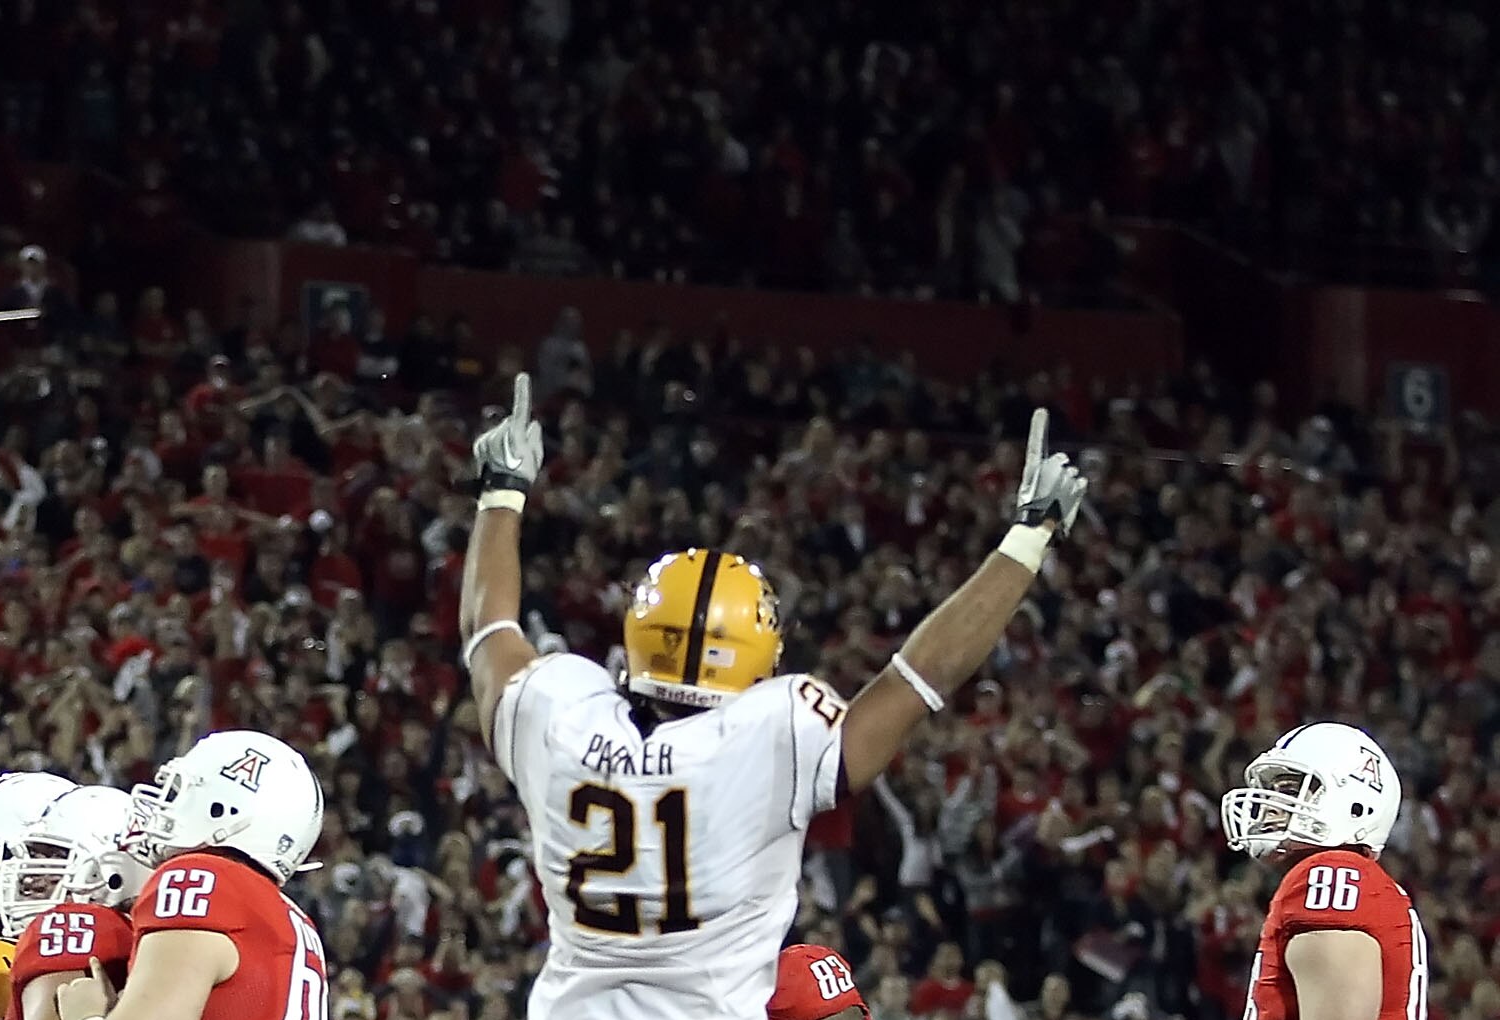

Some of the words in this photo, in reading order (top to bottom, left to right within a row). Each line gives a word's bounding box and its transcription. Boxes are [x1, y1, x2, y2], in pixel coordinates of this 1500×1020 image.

[1404, 368, 1433, 418] 6
[800, 678, 847, 730] 2
[219, 748, 270, 793] A
[1349, 745, 1383, 793] A
[564, 781, 702, 938] 21
[153, 868, 217, 919] 62
[1304, 866, 1361, 911] 86
[38, 911, 96, 957] 55
[809, 954, 855, 1000] 83
